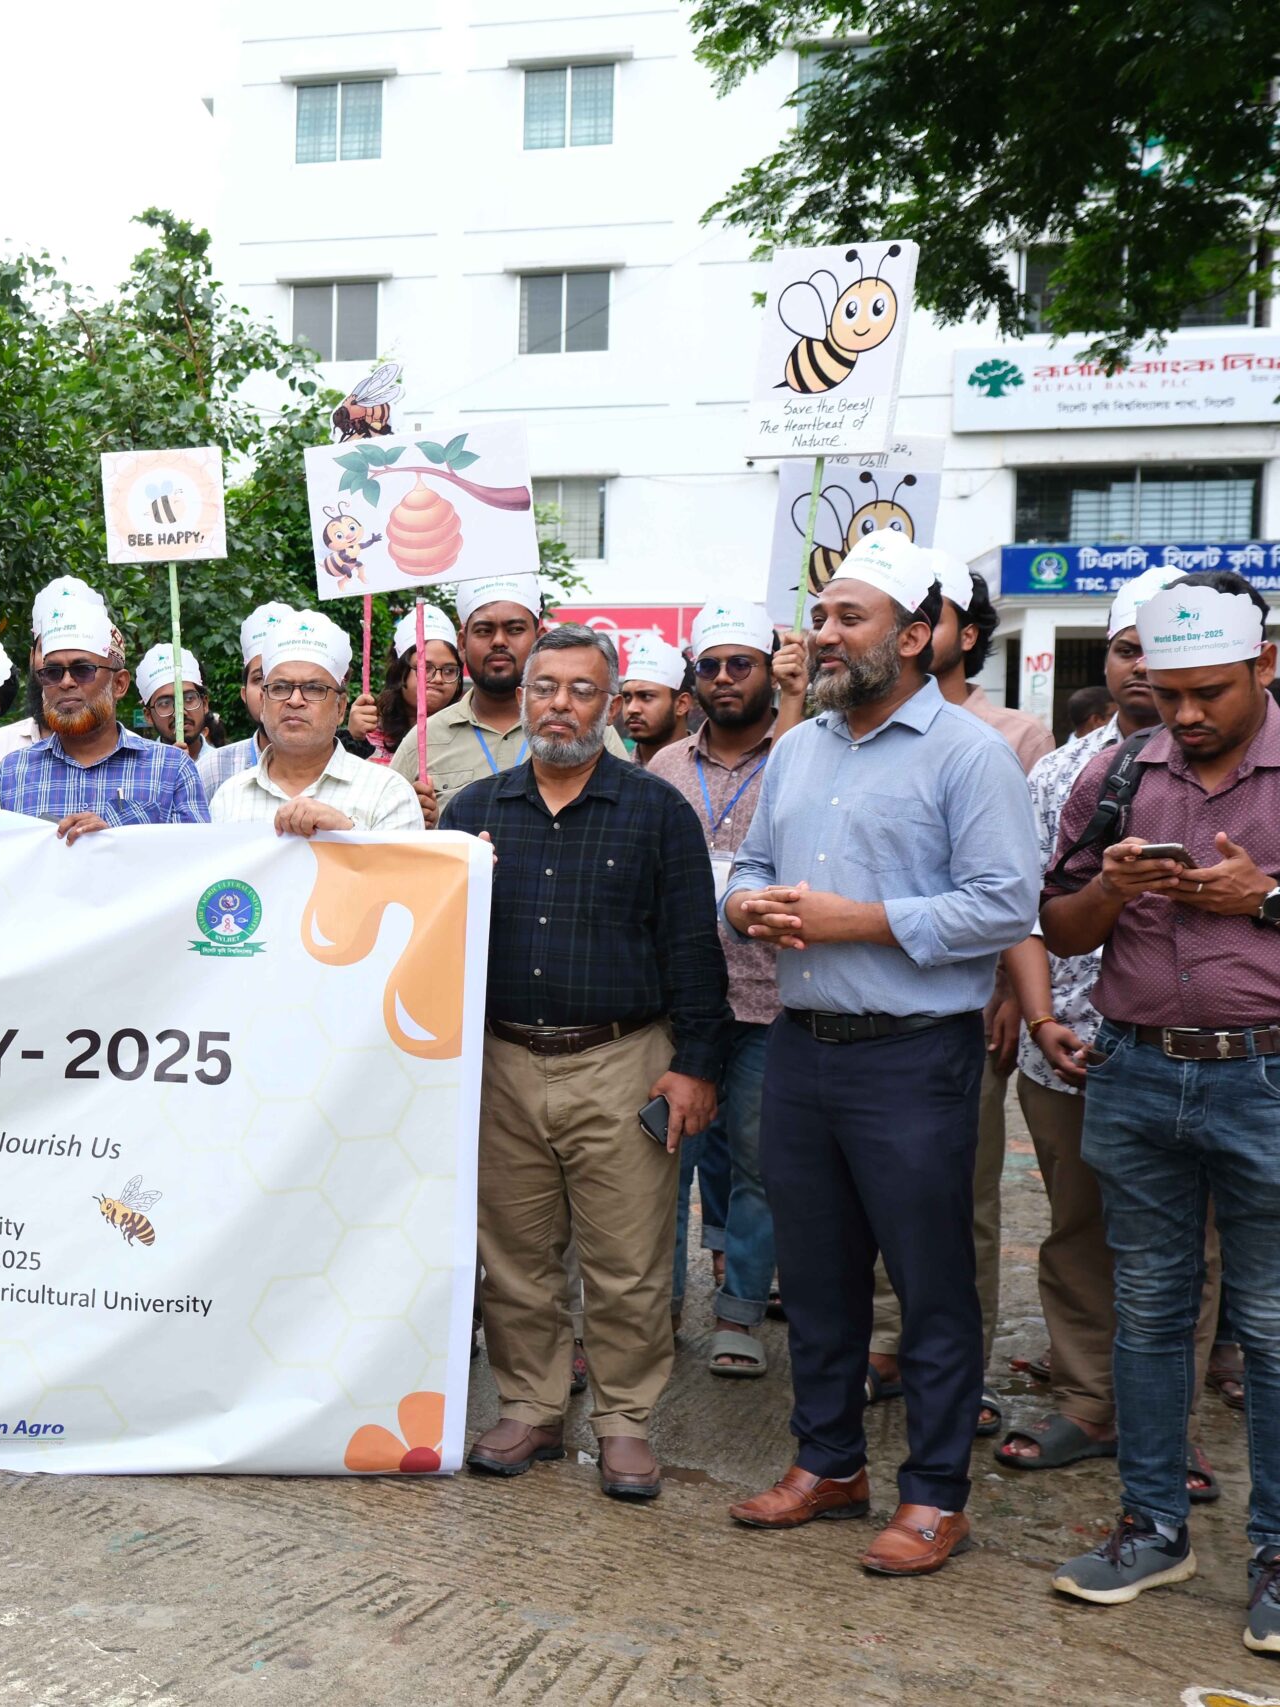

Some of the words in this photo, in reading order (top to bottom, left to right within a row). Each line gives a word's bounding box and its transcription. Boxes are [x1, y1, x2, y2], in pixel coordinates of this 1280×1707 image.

[1033, 382, 1093, 393] RUPALI
[1105, 380, 1147, 391] BANK
[1161, 378, 1190, 388] PLC
[783, 399, 814, 415] Save
[817, 400, 835, 414] the
[837, 397, 874, 413] Bees!!
[759, 420, 779, 435] The
[852, 412, 869, 429] of
[127, 534, 154, 547] BEE
[158, 531, 205, 545] HAPPY!
[1075, 577, 1108, 591] TSC,
[1153, 635, 1171, 644] World
[1172, 634, 1185, 642] Bee
[1025, 652, 1053, 672] NO
[64, 1028, 232, 1085] 2025
[90, 1137, 121, 1160] Us
[103, 1290, 213, 1317] University
[13, 1419, 64, 1437] Agro
